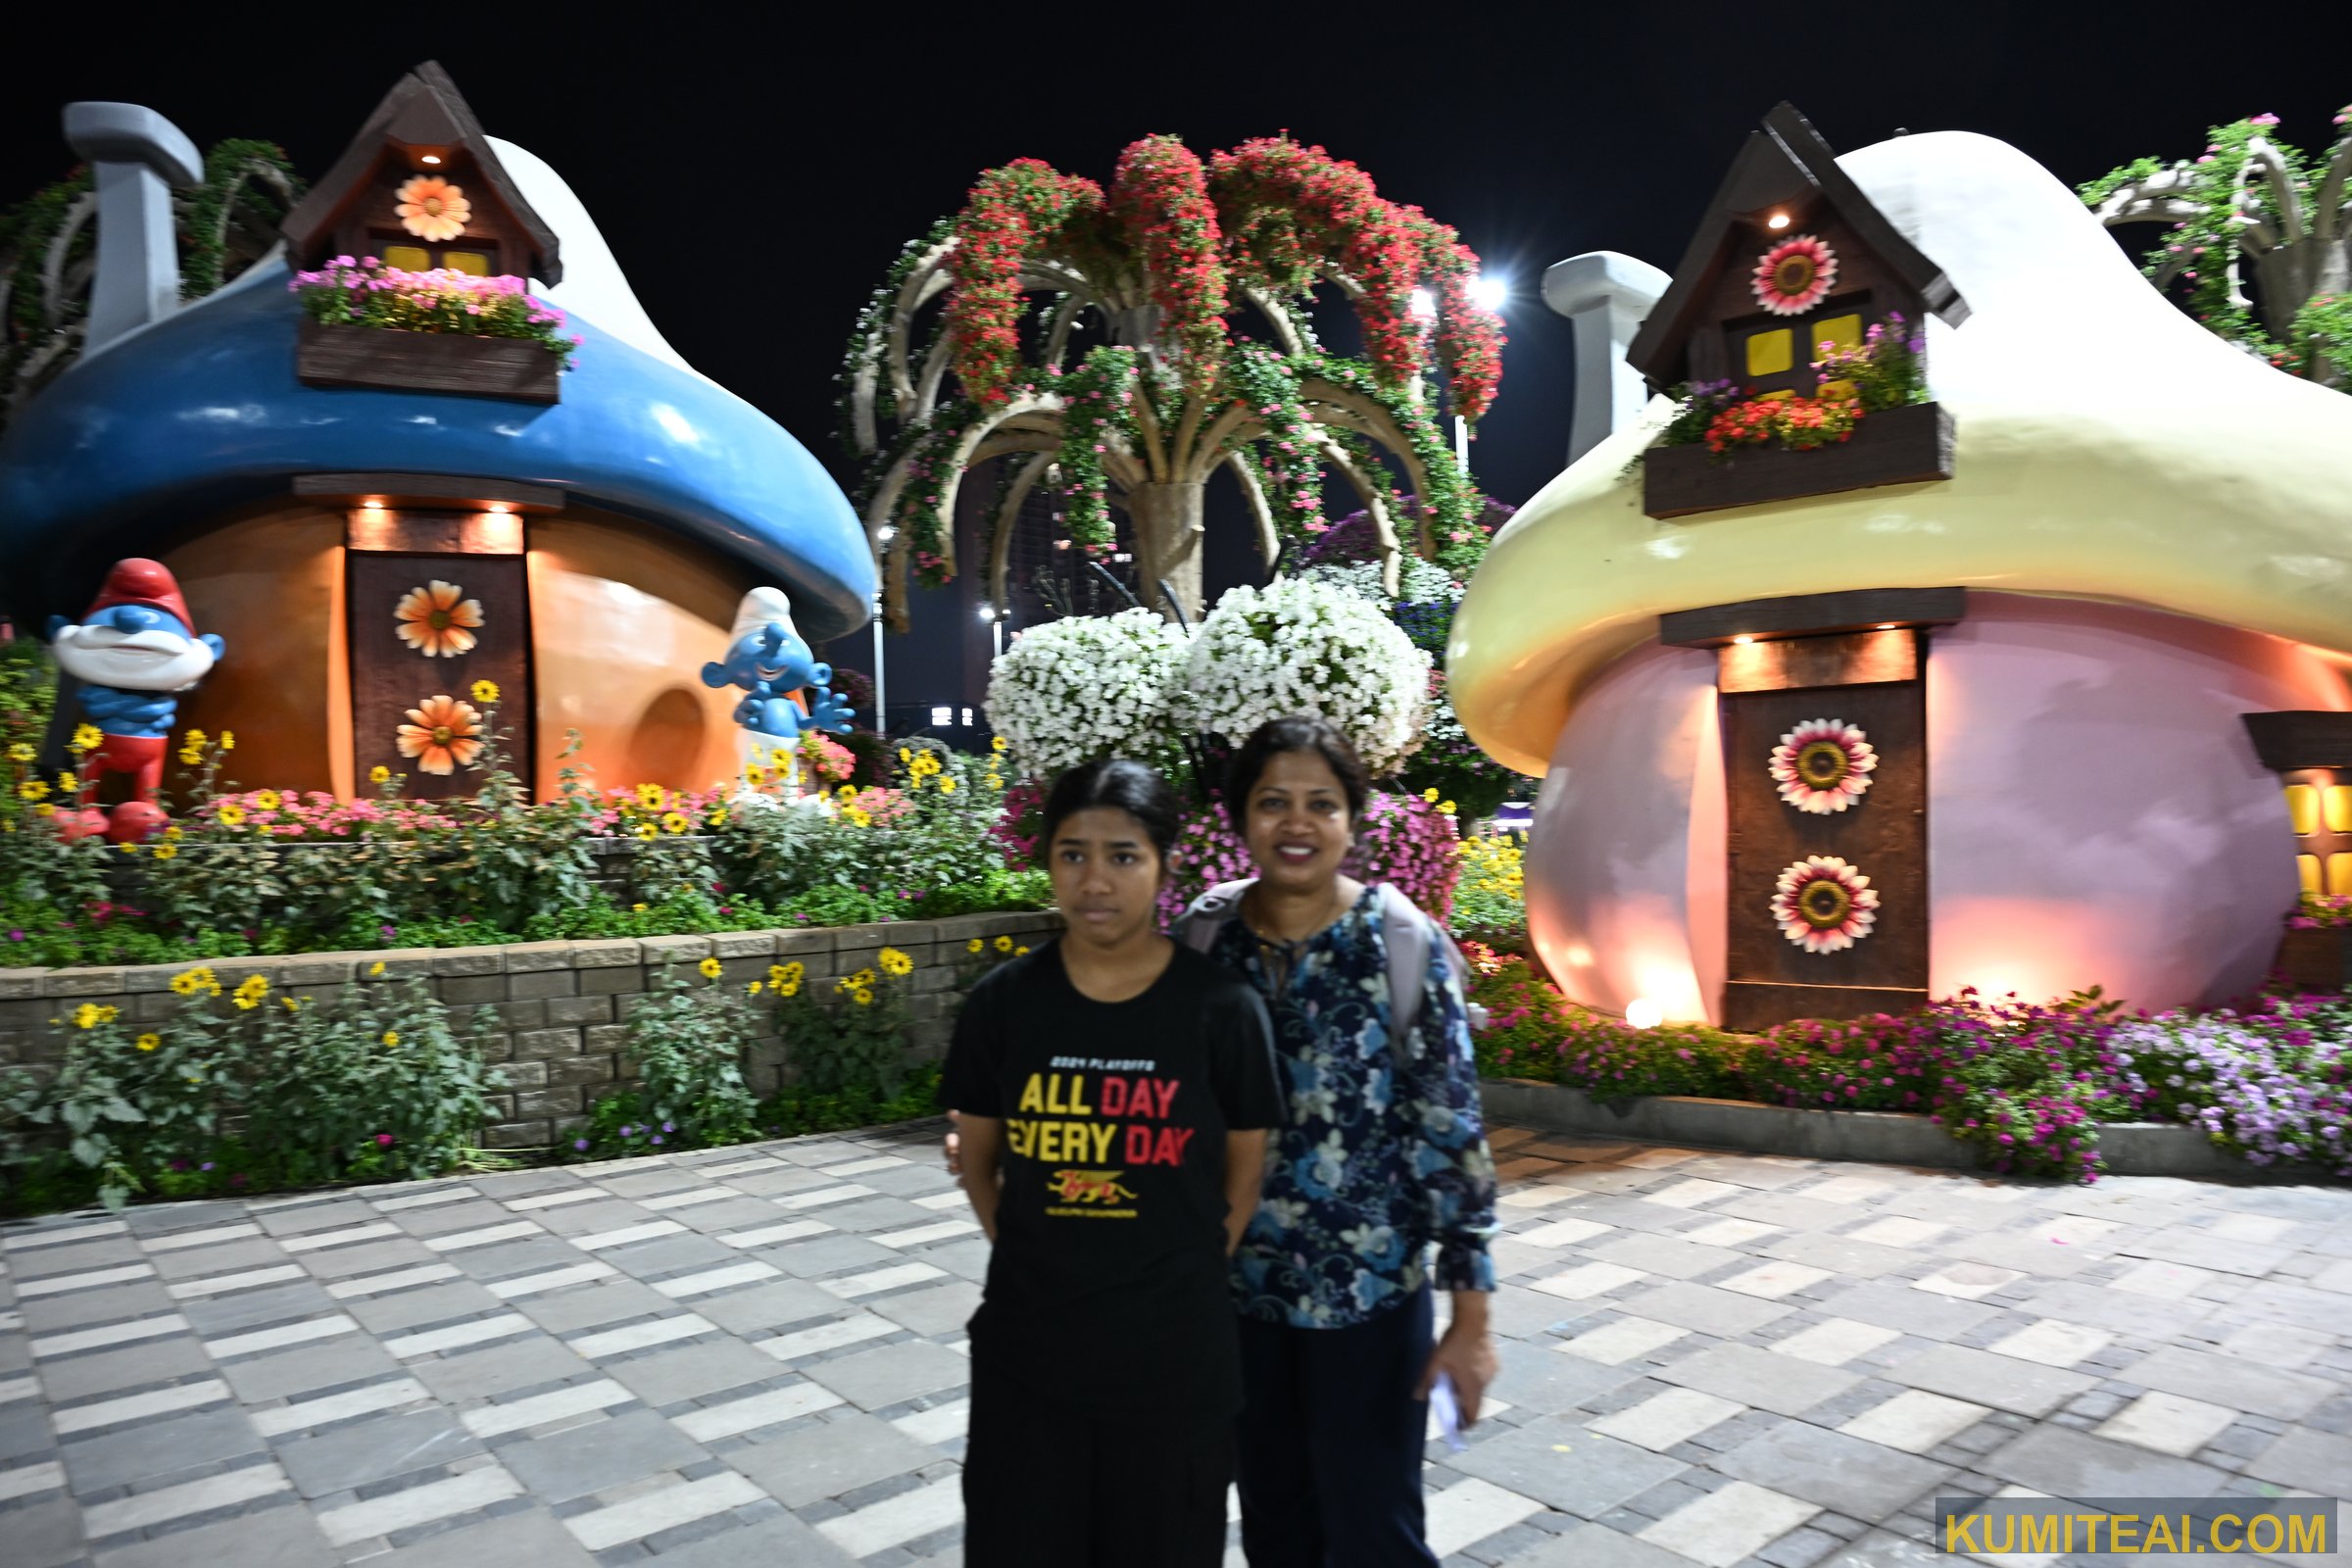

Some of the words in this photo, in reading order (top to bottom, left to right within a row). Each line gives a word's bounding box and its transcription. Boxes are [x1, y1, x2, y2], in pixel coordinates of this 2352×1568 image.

[1089, 1057, 1155, 1071] PLAYOFFS
[1019, 1073, 1093, 1115] ALL
[1101, 1076, 1180, 1119] DAY
[1005, 1118, 1117, 1163] EVERY
[1125, 1124, 1195, 1166] DAY
